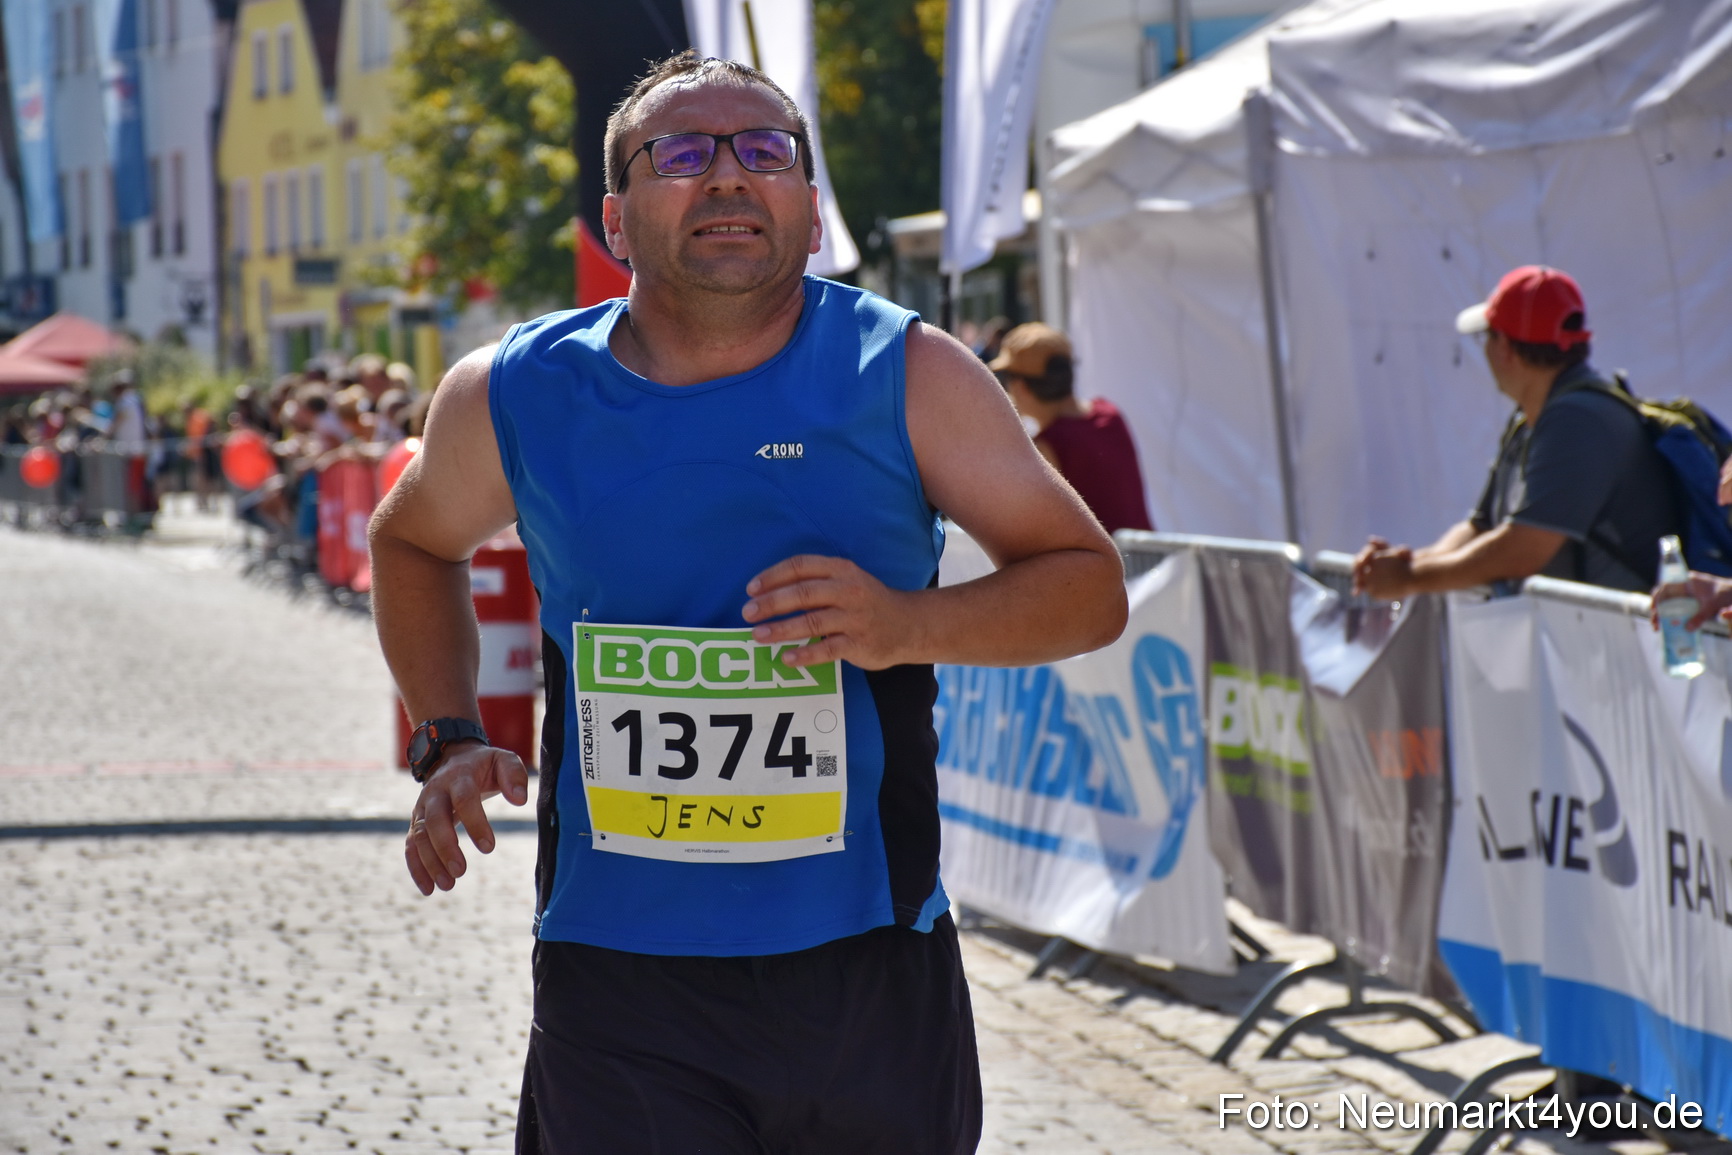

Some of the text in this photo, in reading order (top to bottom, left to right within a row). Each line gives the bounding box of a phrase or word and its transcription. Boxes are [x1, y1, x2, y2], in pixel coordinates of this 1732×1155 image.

[597, 637, 814, 688] BOCK
[611, 709, 813, 781] 1374
[647, 796, 765, 838] JENS
